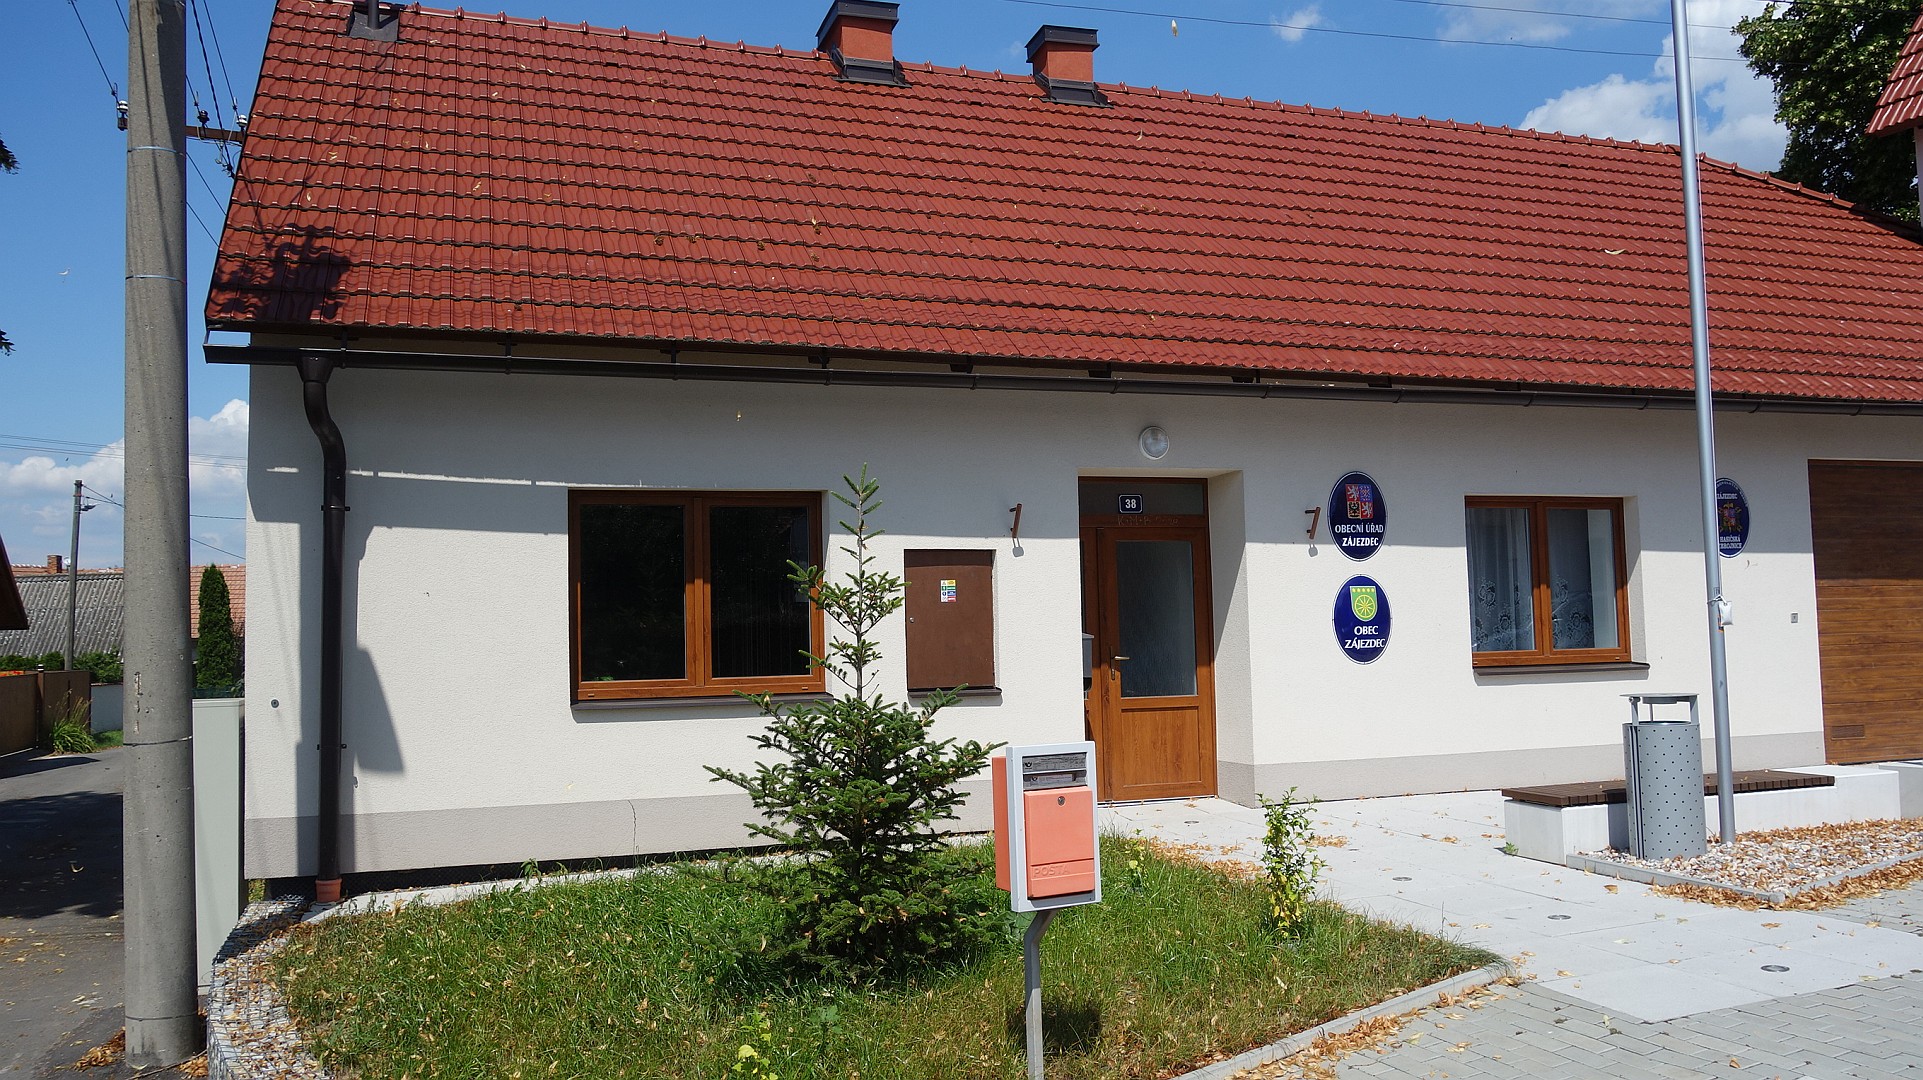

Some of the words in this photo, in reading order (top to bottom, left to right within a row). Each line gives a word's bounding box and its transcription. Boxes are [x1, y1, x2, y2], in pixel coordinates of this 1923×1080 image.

[1125, 498, 1136, 508] 38
[1335, 522, 1363, 533] OBECNÍ
[1365, 522, 1384, 533] ÚŘAD
[1342, 535, 1379, 547] ZÁJEZDEC
[1354, 625, 1379, 636] OBEC
[1344, 637, 1386, 650] ZÁJEZDEC
